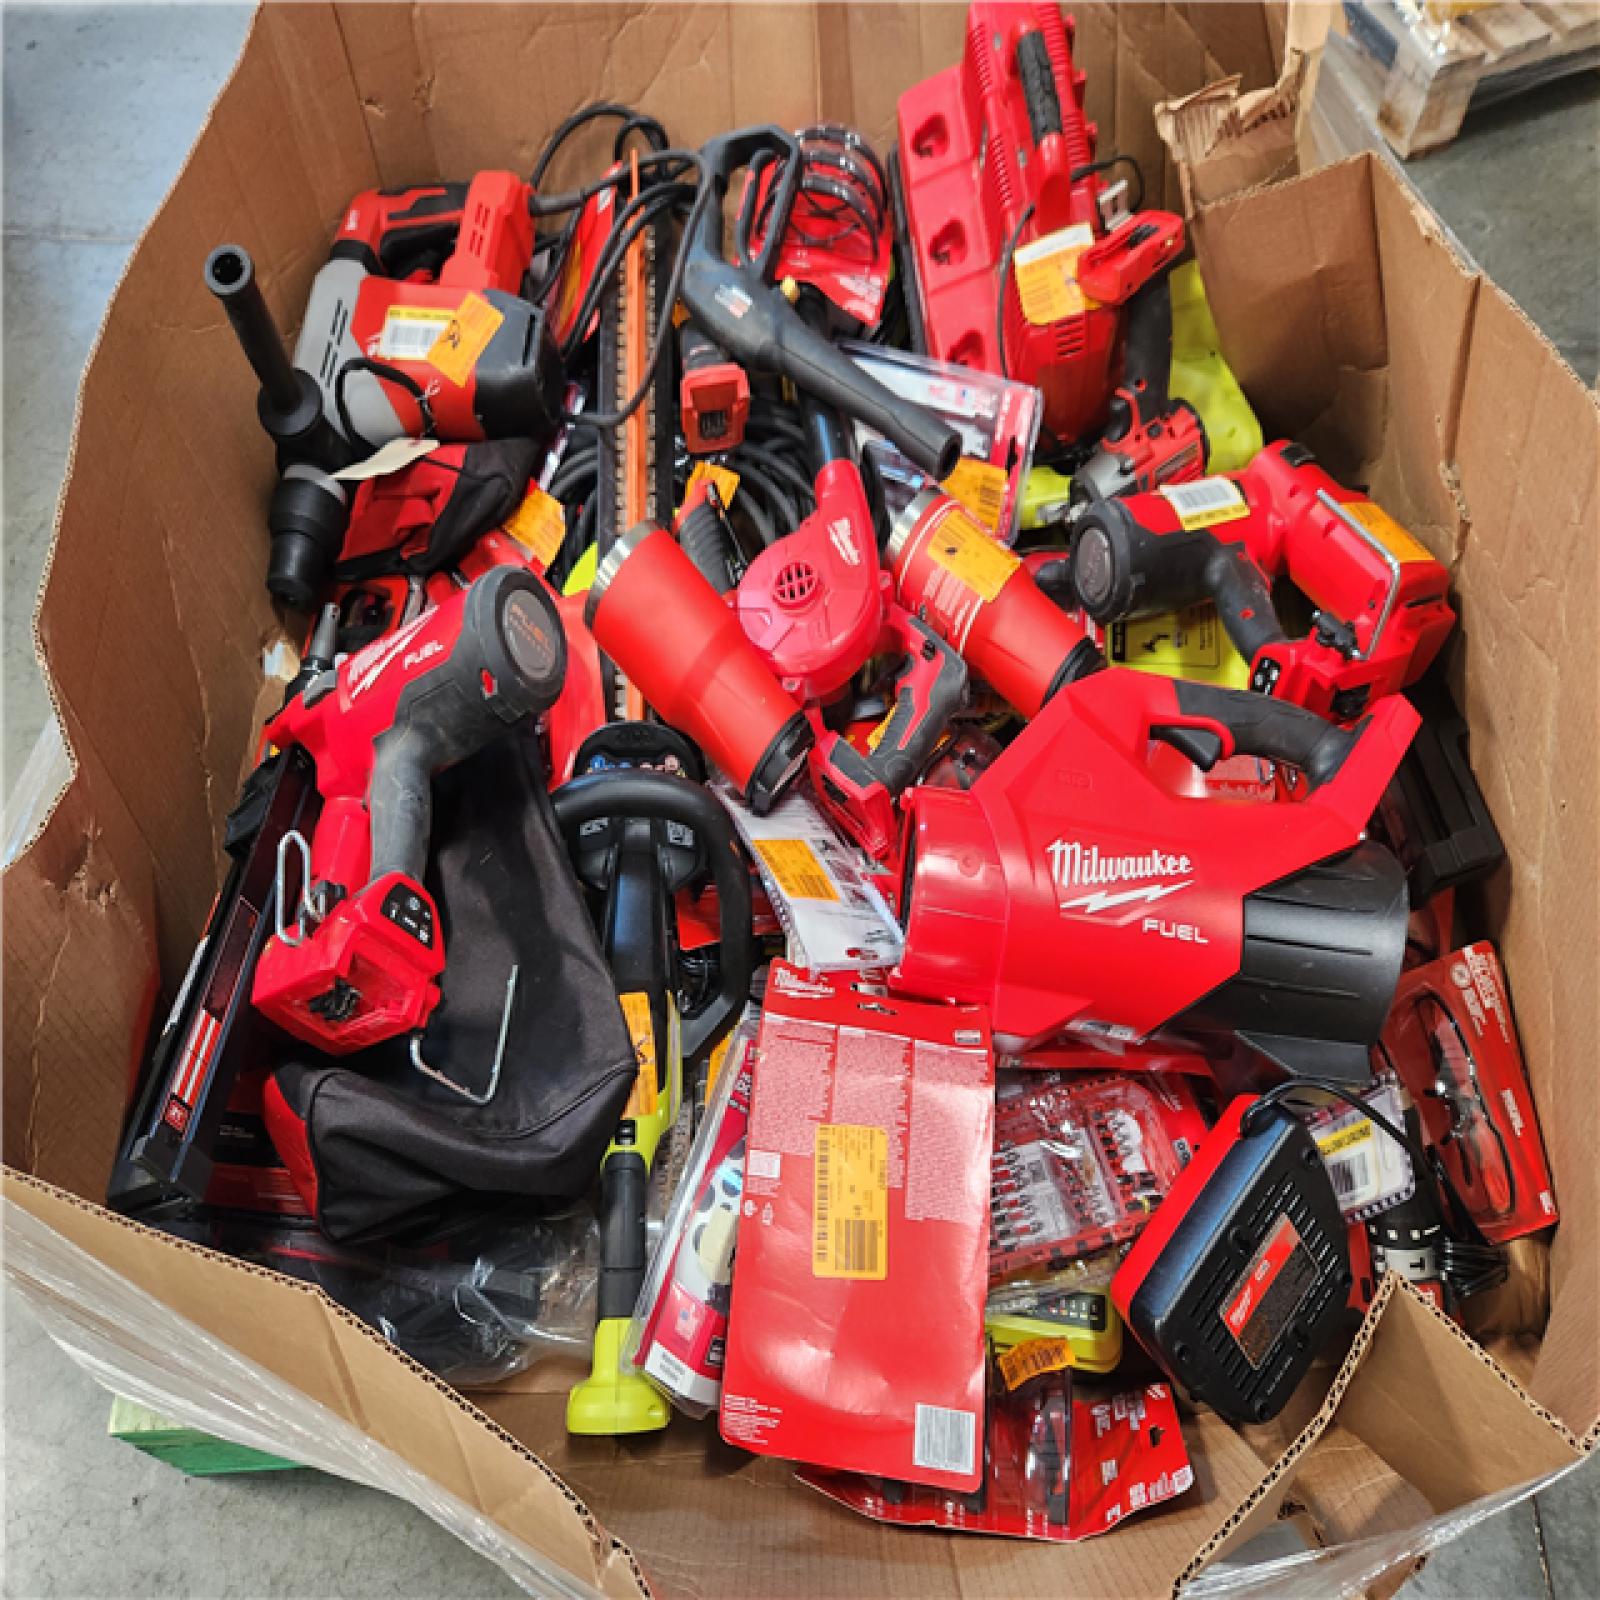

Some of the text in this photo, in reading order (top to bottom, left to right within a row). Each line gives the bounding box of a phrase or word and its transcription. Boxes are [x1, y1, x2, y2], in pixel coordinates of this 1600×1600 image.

[403, 640, 444, 670] FUEL
[1045, 839, 1194, 888] Milwaukee
[1142, 917, 1209, 944] FUEL
